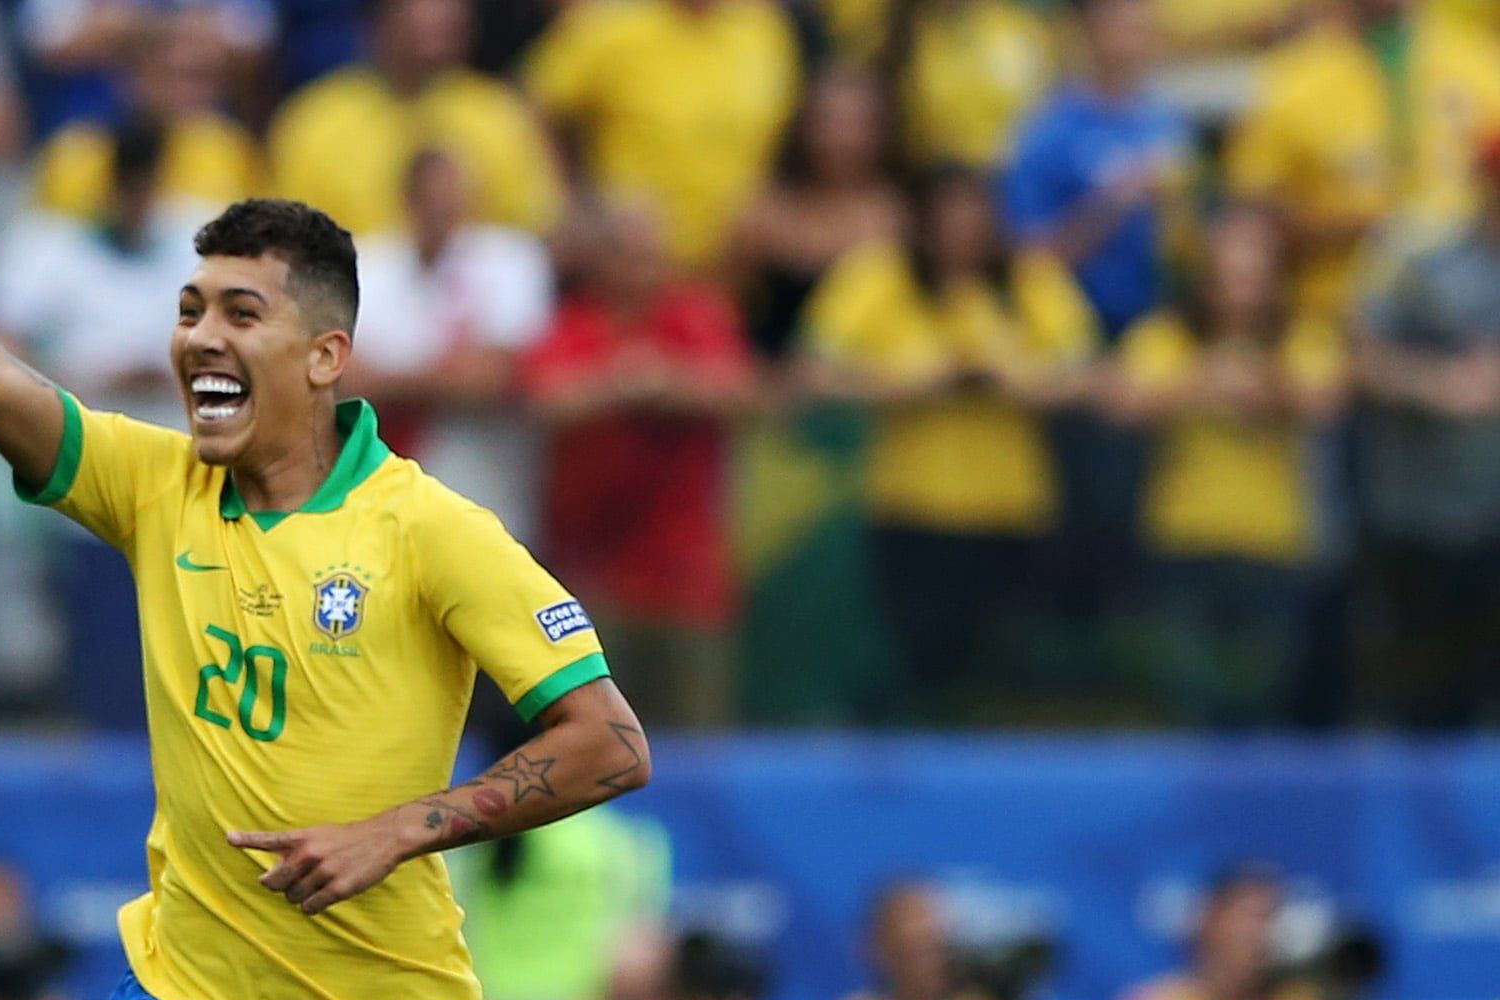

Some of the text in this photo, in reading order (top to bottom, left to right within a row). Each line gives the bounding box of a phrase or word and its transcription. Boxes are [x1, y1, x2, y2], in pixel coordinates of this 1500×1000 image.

[540, 605, 572, 625] Cree
[309, 642, 359, 657] BRASIL
[194, 624, 288, 742] 20
